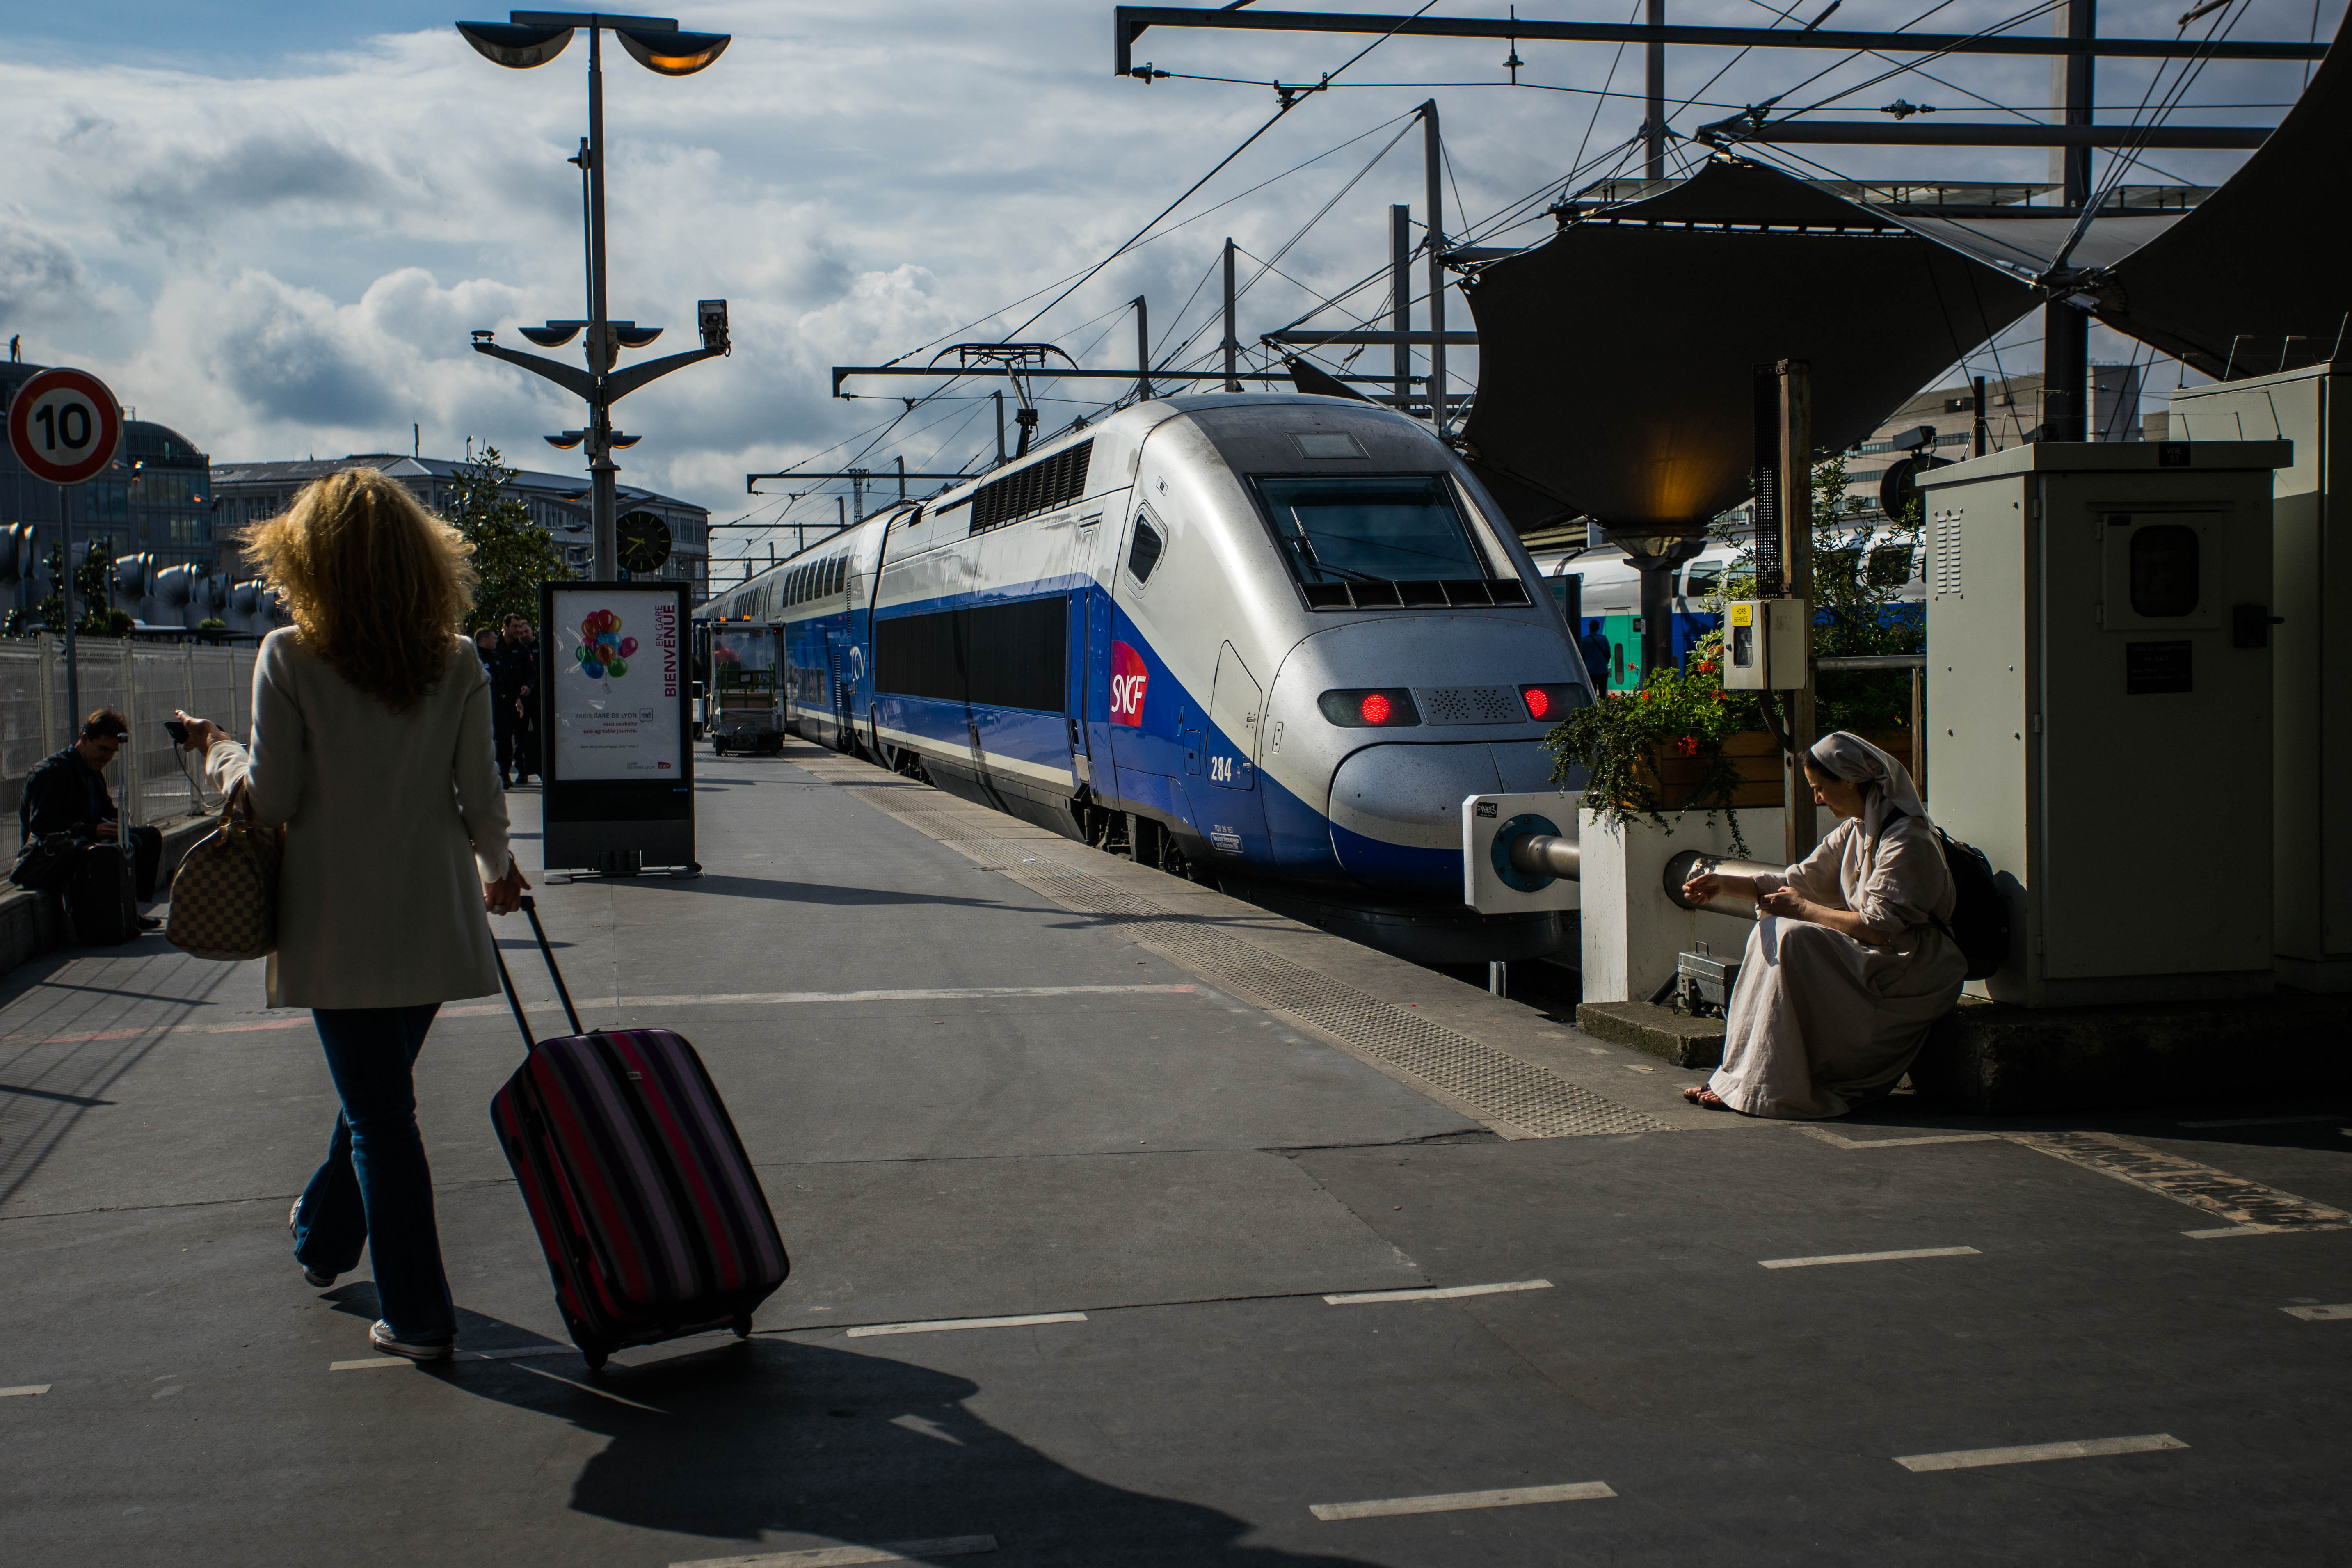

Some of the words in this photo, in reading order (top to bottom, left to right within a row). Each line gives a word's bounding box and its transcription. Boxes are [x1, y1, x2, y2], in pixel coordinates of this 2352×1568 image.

[36, 403, 92, 450] 10
[656, 634, 663, 646] EN
[663, 605, 676, 697] BIENVENUE
[1111, 674, 1146, 714] SNCF
[1211, 756, 1232, 782] 284
